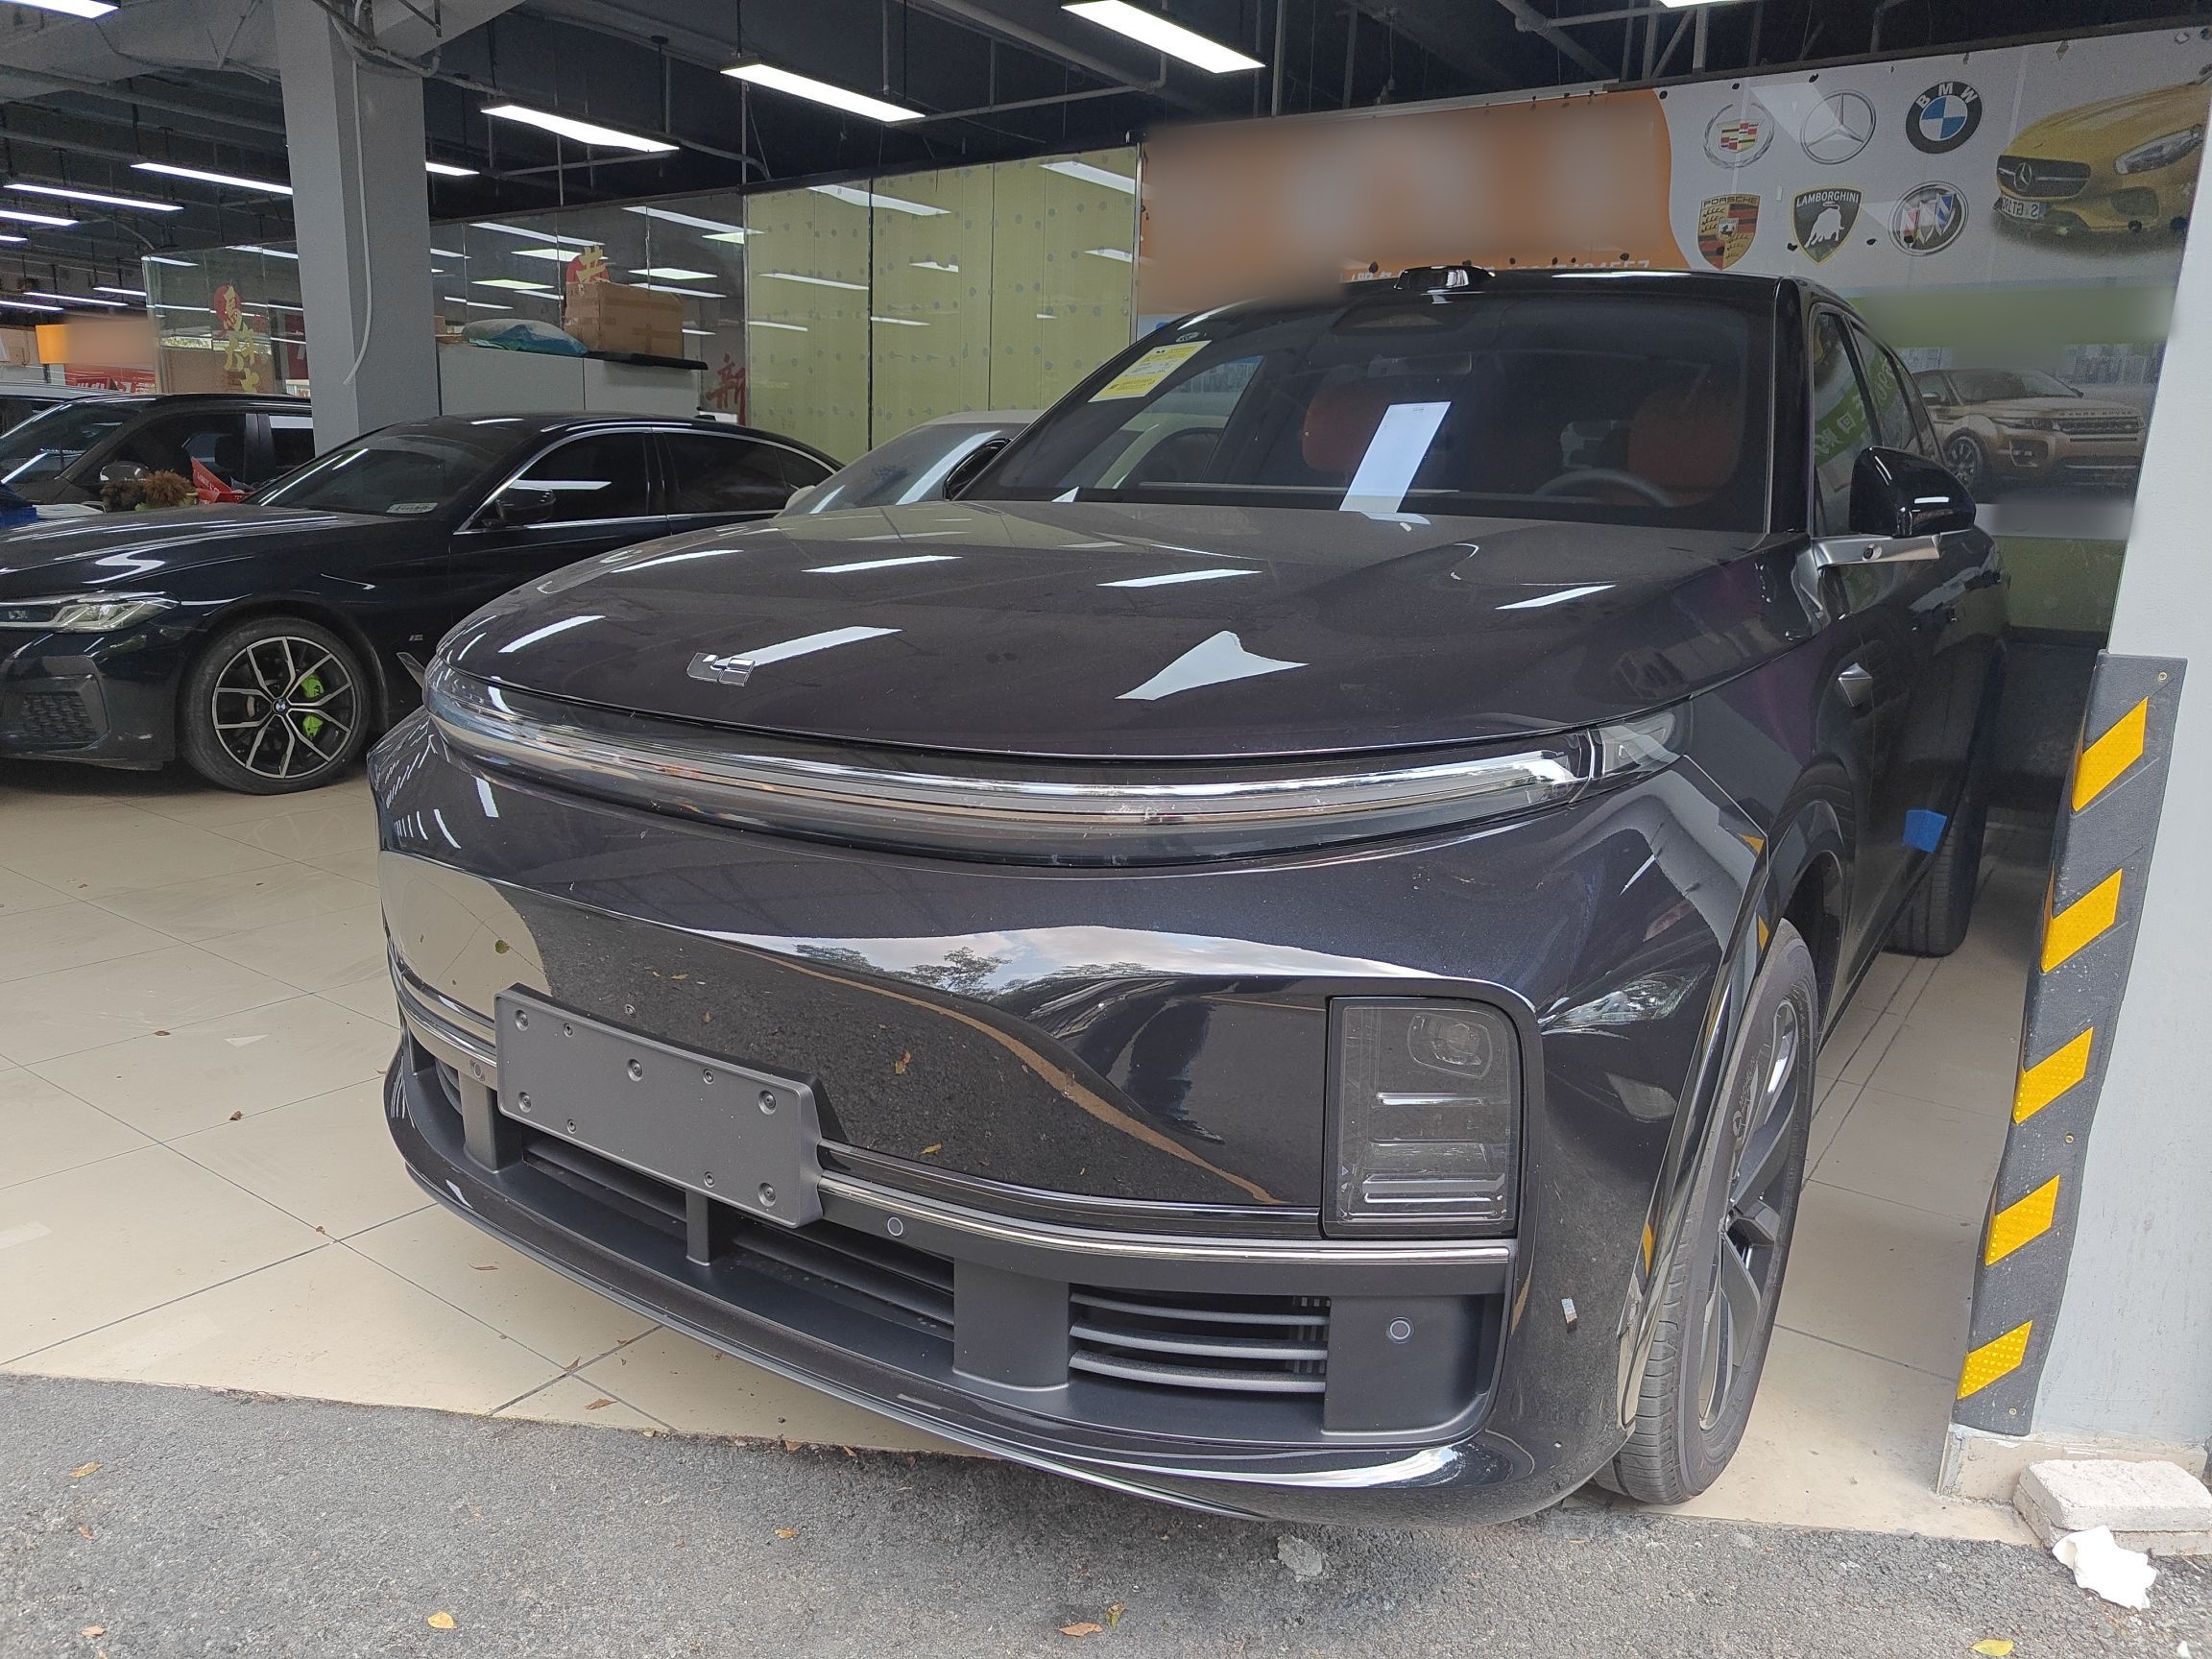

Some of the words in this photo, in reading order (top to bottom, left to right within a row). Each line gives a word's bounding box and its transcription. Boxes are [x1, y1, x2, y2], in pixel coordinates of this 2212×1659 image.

[1915, 82, 1979, 108] BMW
[1703, 196, 1759, 206] PORSCHE
[1796, 191, 1860, 207] LAMBORGHINI
